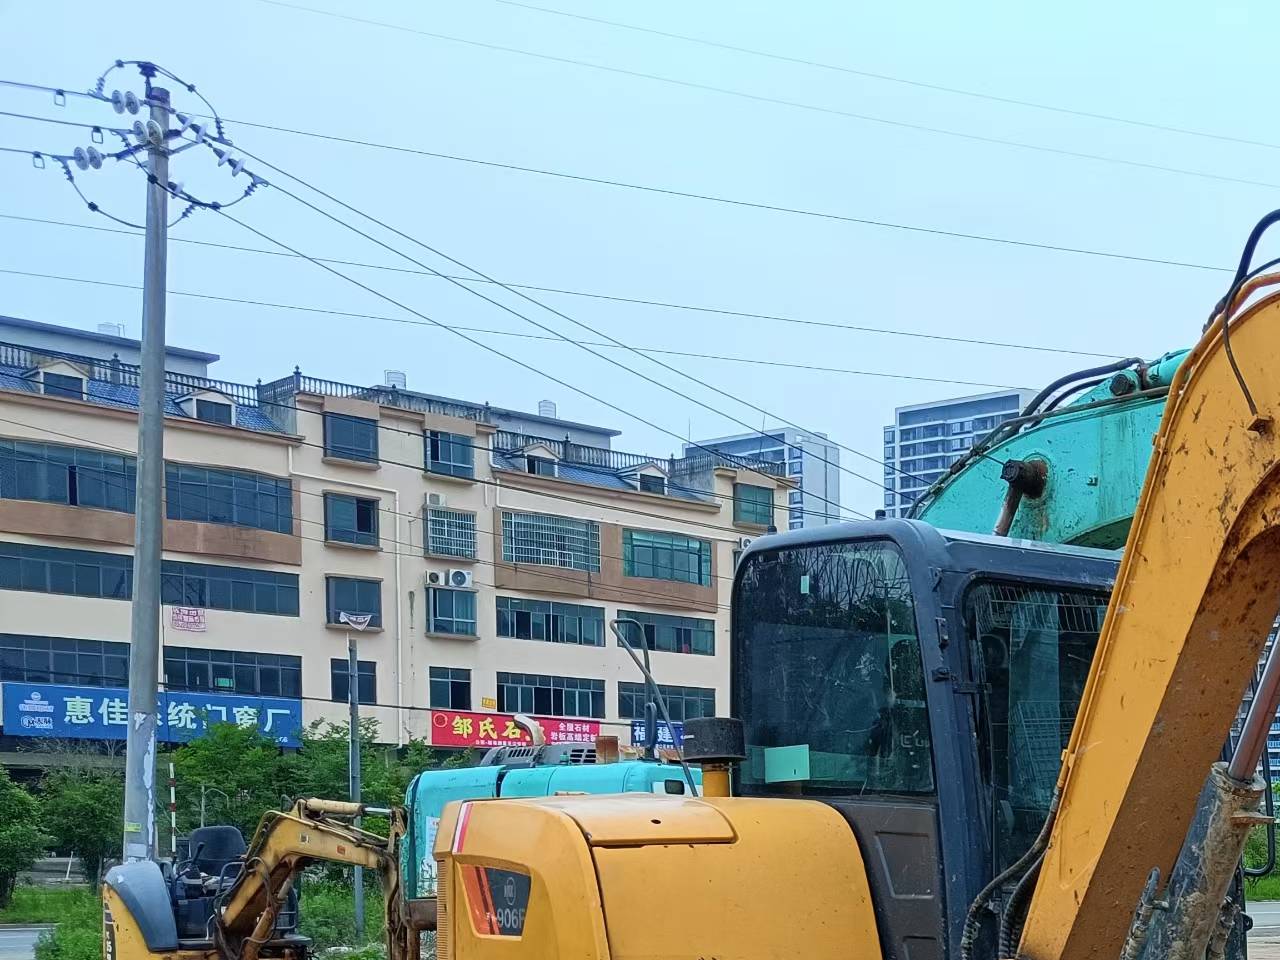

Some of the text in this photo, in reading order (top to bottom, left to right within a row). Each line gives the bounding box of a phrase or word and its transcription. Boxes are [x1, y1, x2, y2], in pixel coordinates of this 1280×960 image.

[62, 695, 291, 733] 惠佳统门窗厂
